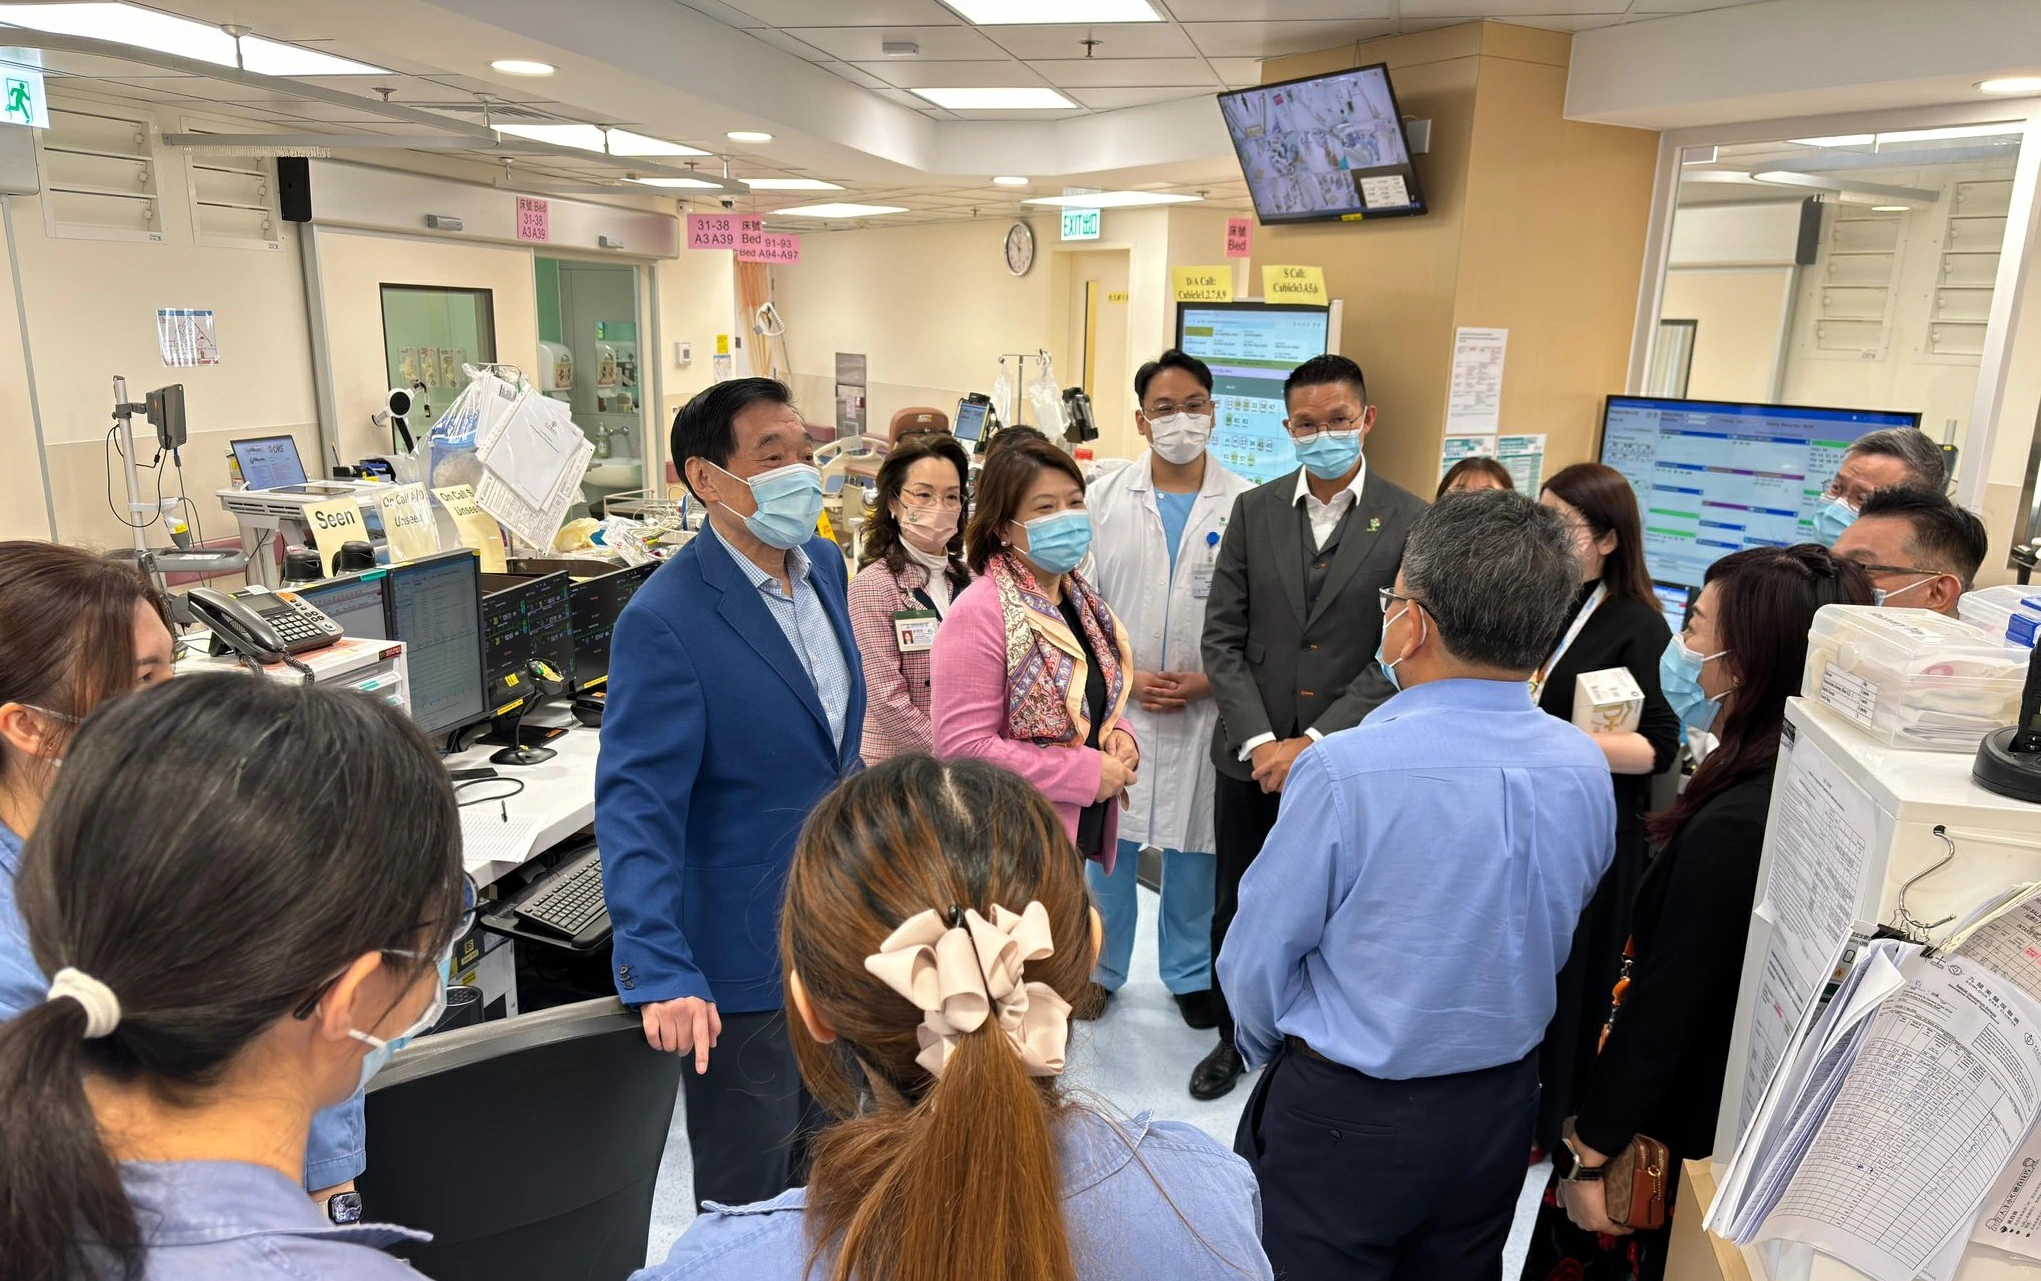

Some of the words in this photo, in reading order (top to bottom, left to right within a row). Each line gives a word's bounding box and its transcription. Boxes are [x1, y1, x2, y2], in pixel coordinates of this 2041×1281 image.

[534, 201, 547, 213] Bed
[524, 213, 543, 226] 31-38
[697, 220, 730, 231] 31-38
[1063, 214, 1082, 237] EXIT
[1083, 213, 1097, 235] 出口
[741, 220, 761, 232] 床號
[522, 226, 532, 238] A3
[532, 228, 546, 240] A39
[741, 233, 762, 244] Bed
[695, 234, 710, 245] A3
[711, 234, 734, 245] A39
[764, 238, 792, 249] 91-93
[1228, 239, 1247, 251] Bed
[758, 249, 799, 260] A94-A97
[440, 491, 453, 502] On
[452, 489, 466, 501] Call
[453, 504, 482, 517] Unseen
[315, 509, 356, 530] Seen
